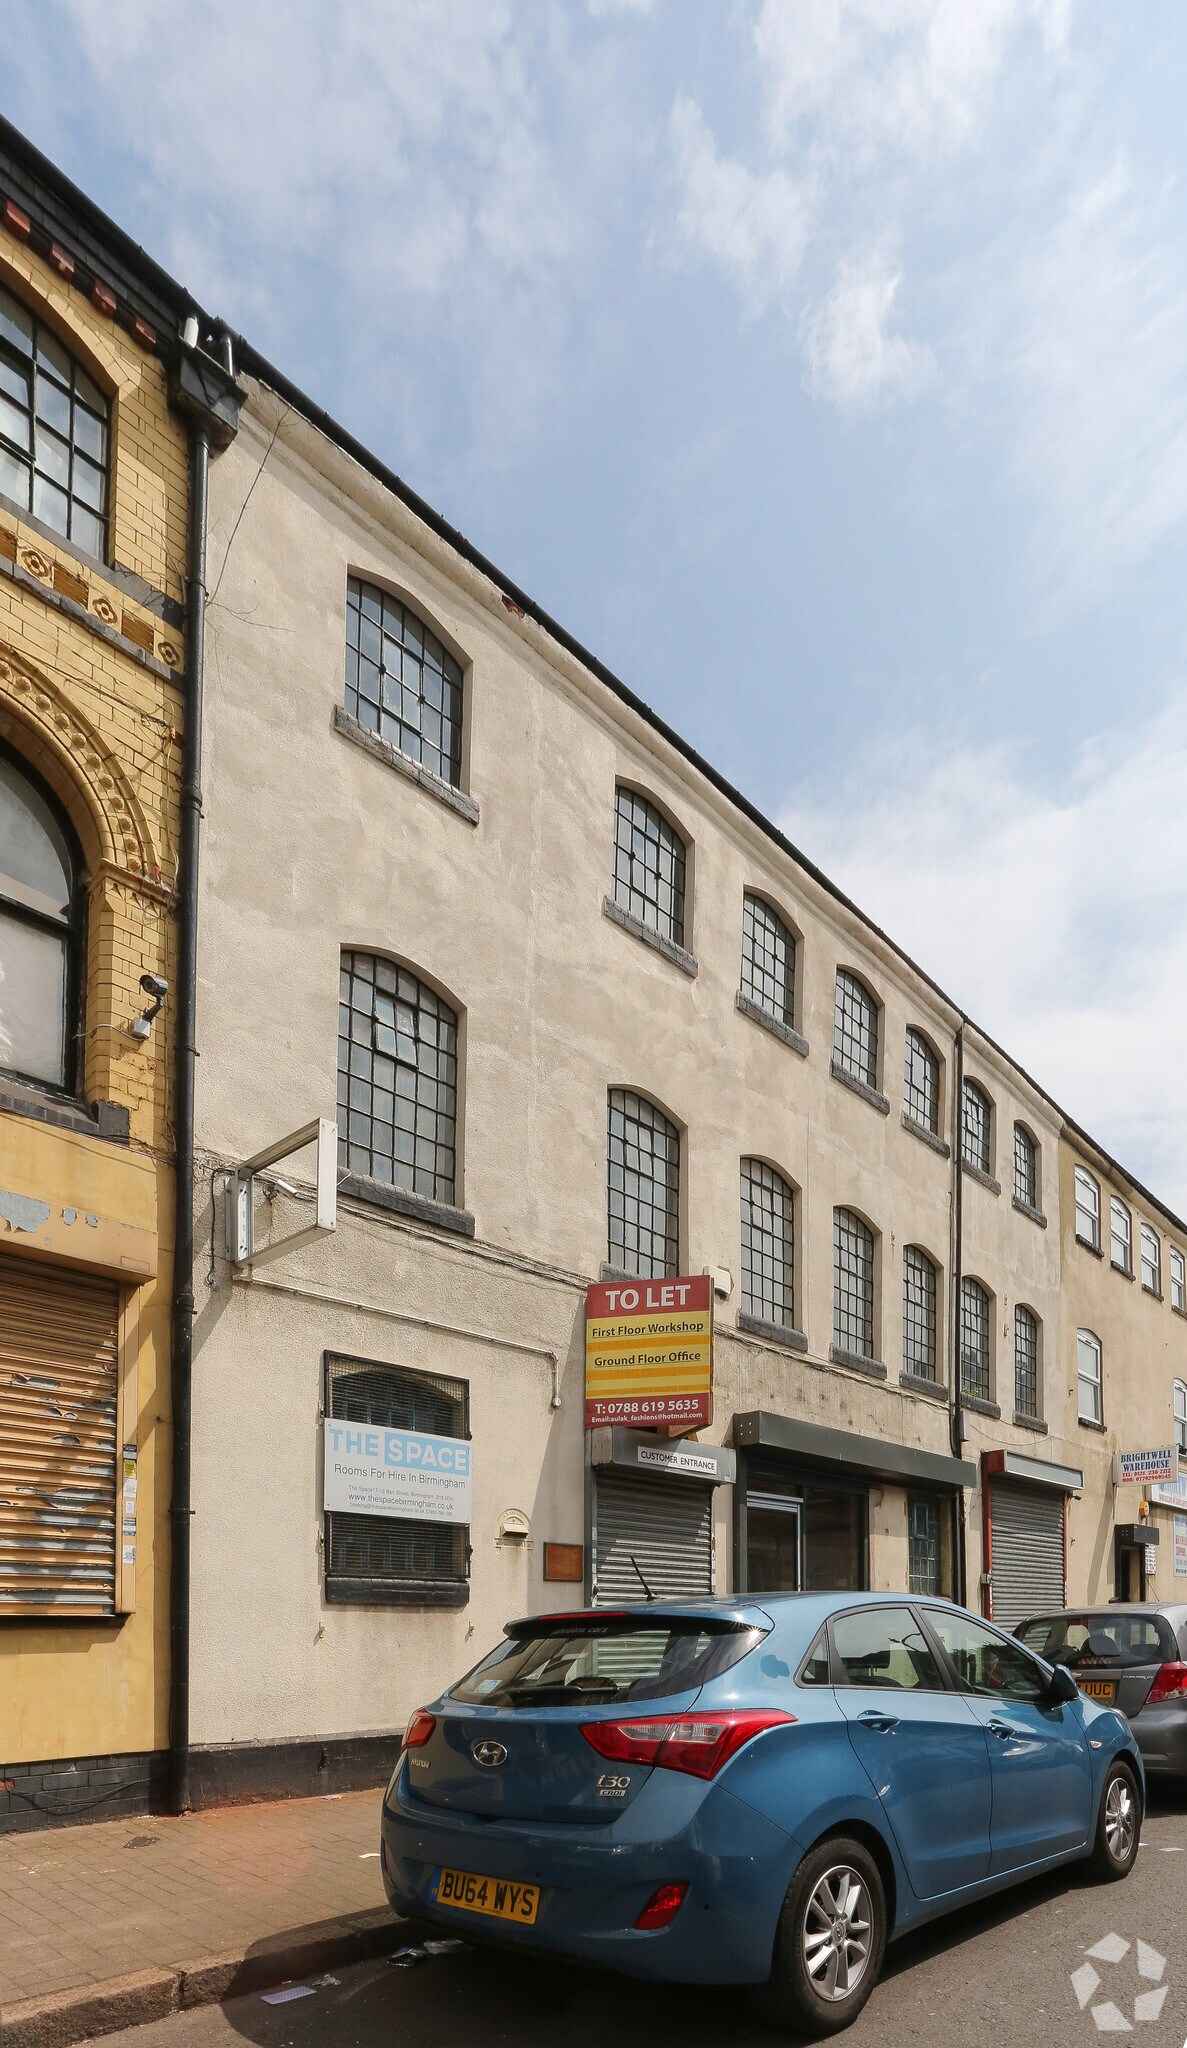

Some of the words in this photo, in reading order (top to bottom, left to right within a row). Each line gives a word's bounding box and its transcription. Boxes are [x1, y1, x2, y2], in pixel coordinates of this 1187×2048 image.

[605, 1288, 640, 1311] TO
[646, 1284, 691, 1308] LET
[592, 1327, 616, 1338] First
[618, 1325, 646, 1336] Floor
[648, 1321, 704, 1333] Workshop
[594, 1355, 635, 1366] Ground
[638, 1353, 666, 1364] Floor
[668, 1350, 701, 1362] Office
[595, 1403, 606, 1414] T:
[607, 1401, 639, 1413] 0788
[641, 1401, 665, 1412] 619
[667, 1399, 699, 1411] 5635
[591, 1411, 703, 1423] Email:aulak_fashions@hotmail.com
[329, 1428, 379, 1457] THE
[388, 1438, 467, 1472] SPACE
[1121, 1450, 1172, 1463] BRIGHTWELL
[640, 1450, 678, 1464] CUSTOMER
[680, 1457, 716, 1471] ENTRANCE
[1123, 1460, 1170, 1472] WAREHOUSE
[334, 1463, 368, 1477] Rooms
[370, 1467, 386, 1479] For
[388, 1470, 406, 1482] Hire
[408, 1473, 417, 1483] In
[419, 1474, 466, 1489] Birmingham
[348, 1494, 454, 1511] www.thespacebirmingham.co.uk
[1084, 1683, 1111, 1696] UUC
[596, 1774, 631, 1788] i30
[442, 1872, 489, 1907] BU64
[493, 1882, 536, 1917] WYS
